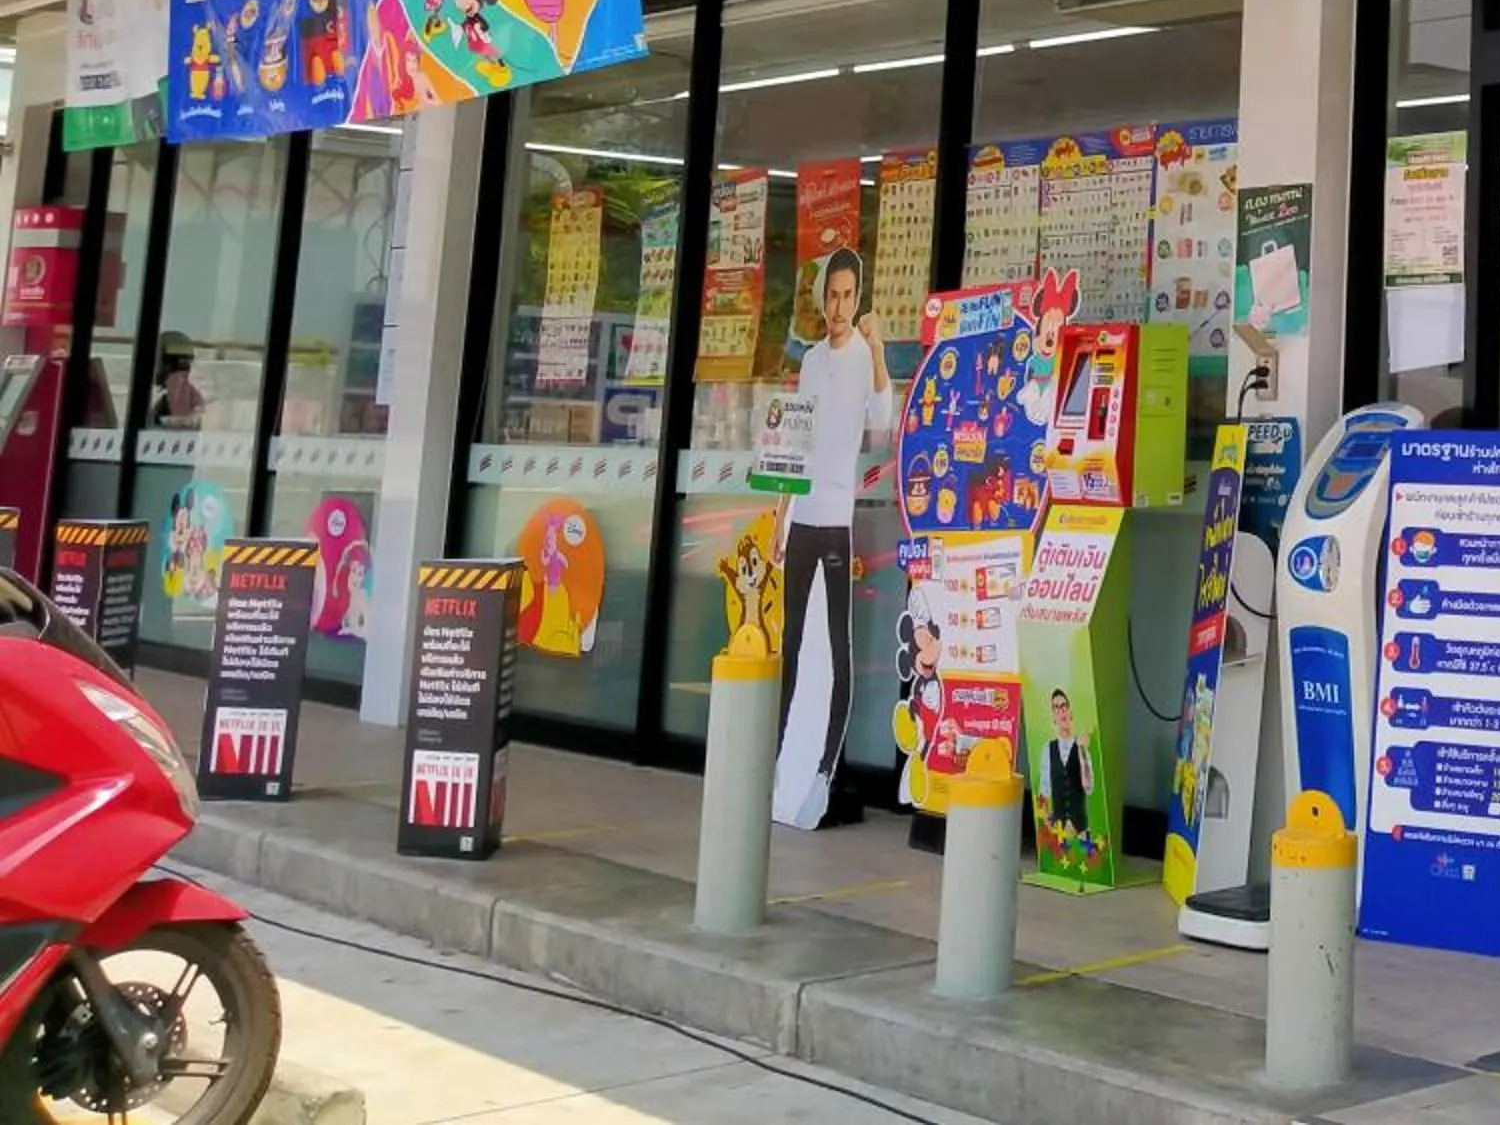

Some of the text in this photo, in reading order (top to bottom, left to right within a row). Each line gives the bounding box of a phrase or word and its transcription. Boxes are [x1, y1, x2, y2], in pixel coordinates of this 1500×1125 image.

[1037, 541, 1107, 574] ตู้เติมเงิน
[230, 572, 288, 589] NETFLIX
[1027, 575, 1098, 604] ออนไลน์
[424, 598, 478, 617] NETFLIX
[1302, 680, 1340, 704] BMI
